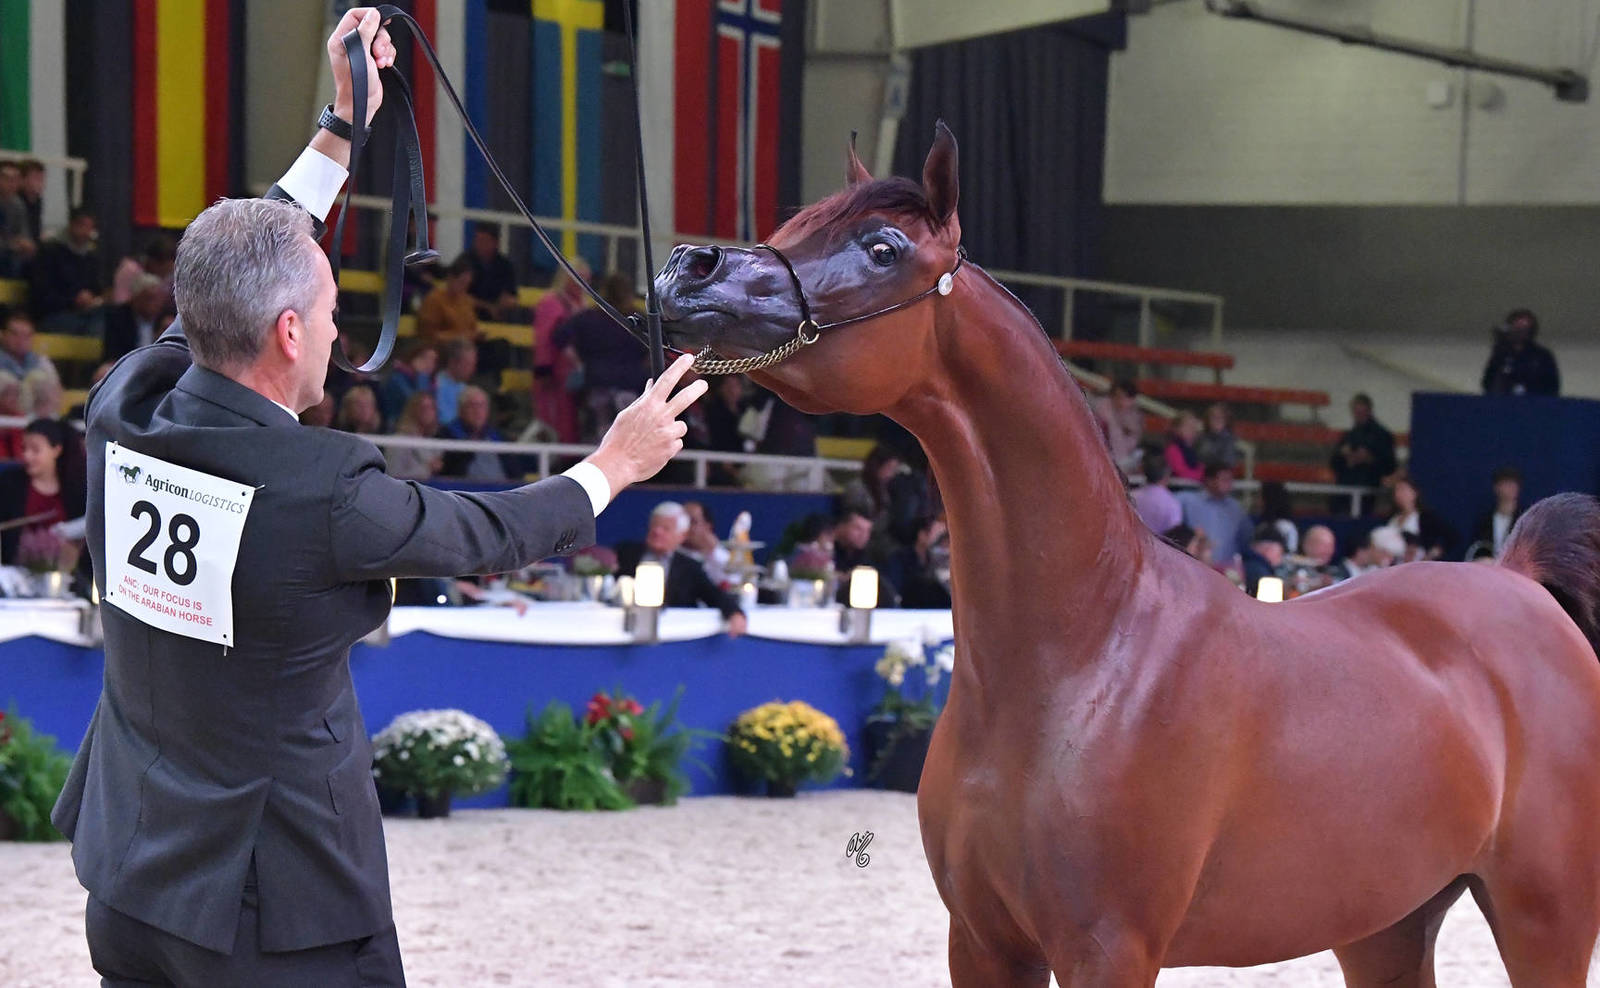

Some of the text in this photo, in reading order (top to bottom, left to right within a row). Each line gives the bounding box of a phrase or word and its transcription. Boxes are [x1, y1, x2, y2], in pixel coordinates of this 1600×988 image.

[127, 500, 201, 586] 28
[119, 584, 213, 626] ON THE ARABIAN HORSE
[143, 584, 159, 598] OUR
[161, 591, 191, 608] FOCUS
[193, 601, 203, 611] IS
